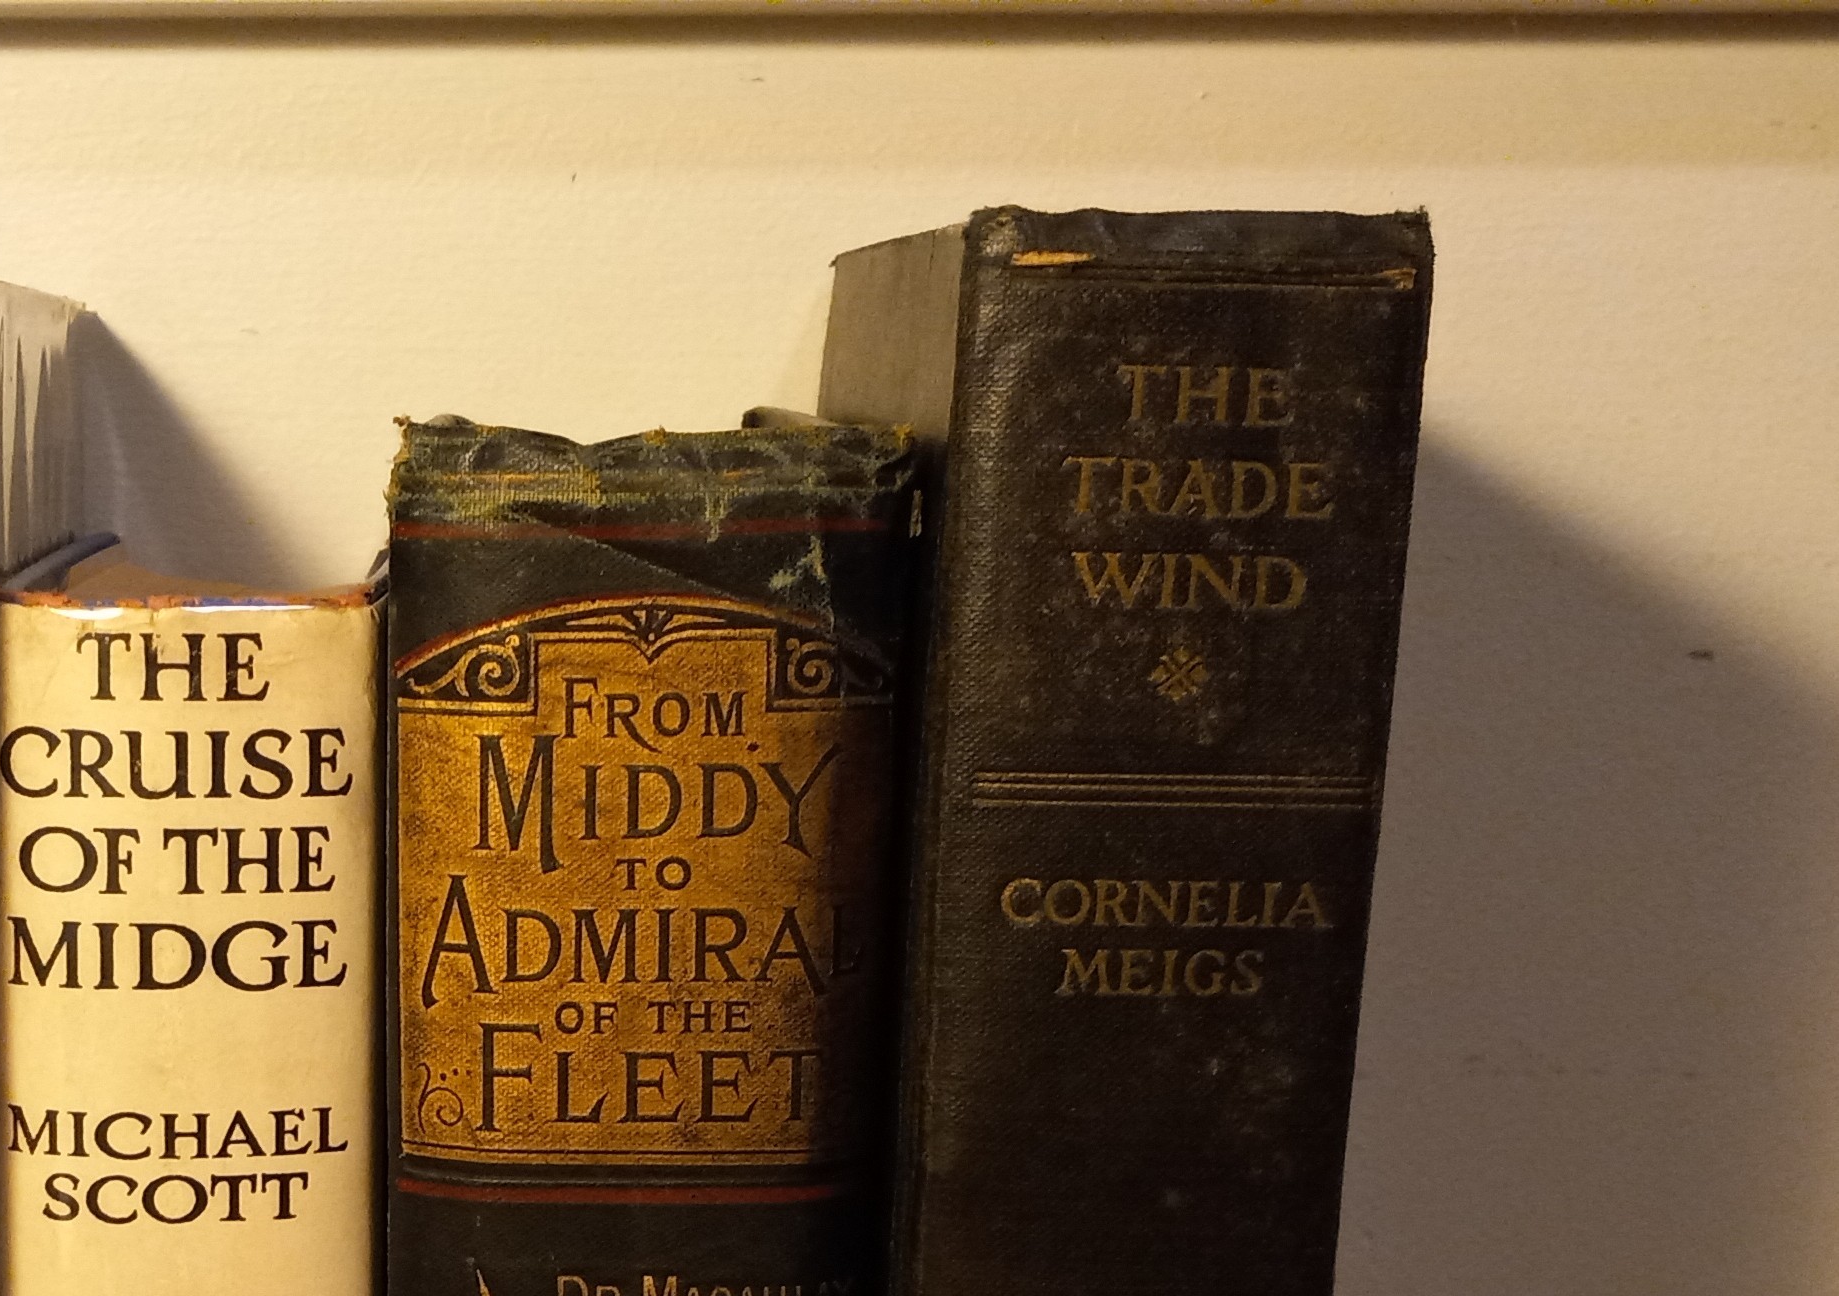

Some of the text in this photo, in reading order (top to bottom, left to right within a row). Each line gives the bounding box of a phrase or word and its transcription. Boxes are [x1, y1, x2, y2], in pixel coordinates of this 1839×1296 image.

[1117, 364, 1294, 429] THE
[1062, 455, 1335, 520] TRADE
[1071, 551, 1308, 611] WIND
[76, 631, 271, 702] THE
[562, 677, 745, 753] FROM
[0, 725, 353, 799] CRUISE
[473, 733, 843, 874] MIDDY
[19, 826, 335, 894] OF THE
[615, 857, 692, 891] TO
[1000, 876, 1334, 930] CORNELIA
[8, 916, 348, 992] MIDGE
[421, 874, 861, 1010] ADMIRAL
[1056, 947, 1263, 997] MEIGS
[554, 1001, 753, 1034] OF THE
[476, 1022, 825, 1133] FLEET
[8, 1103, 348, 1160] MICHAEL
[42, 1172, 309, 1224] SCOTT
